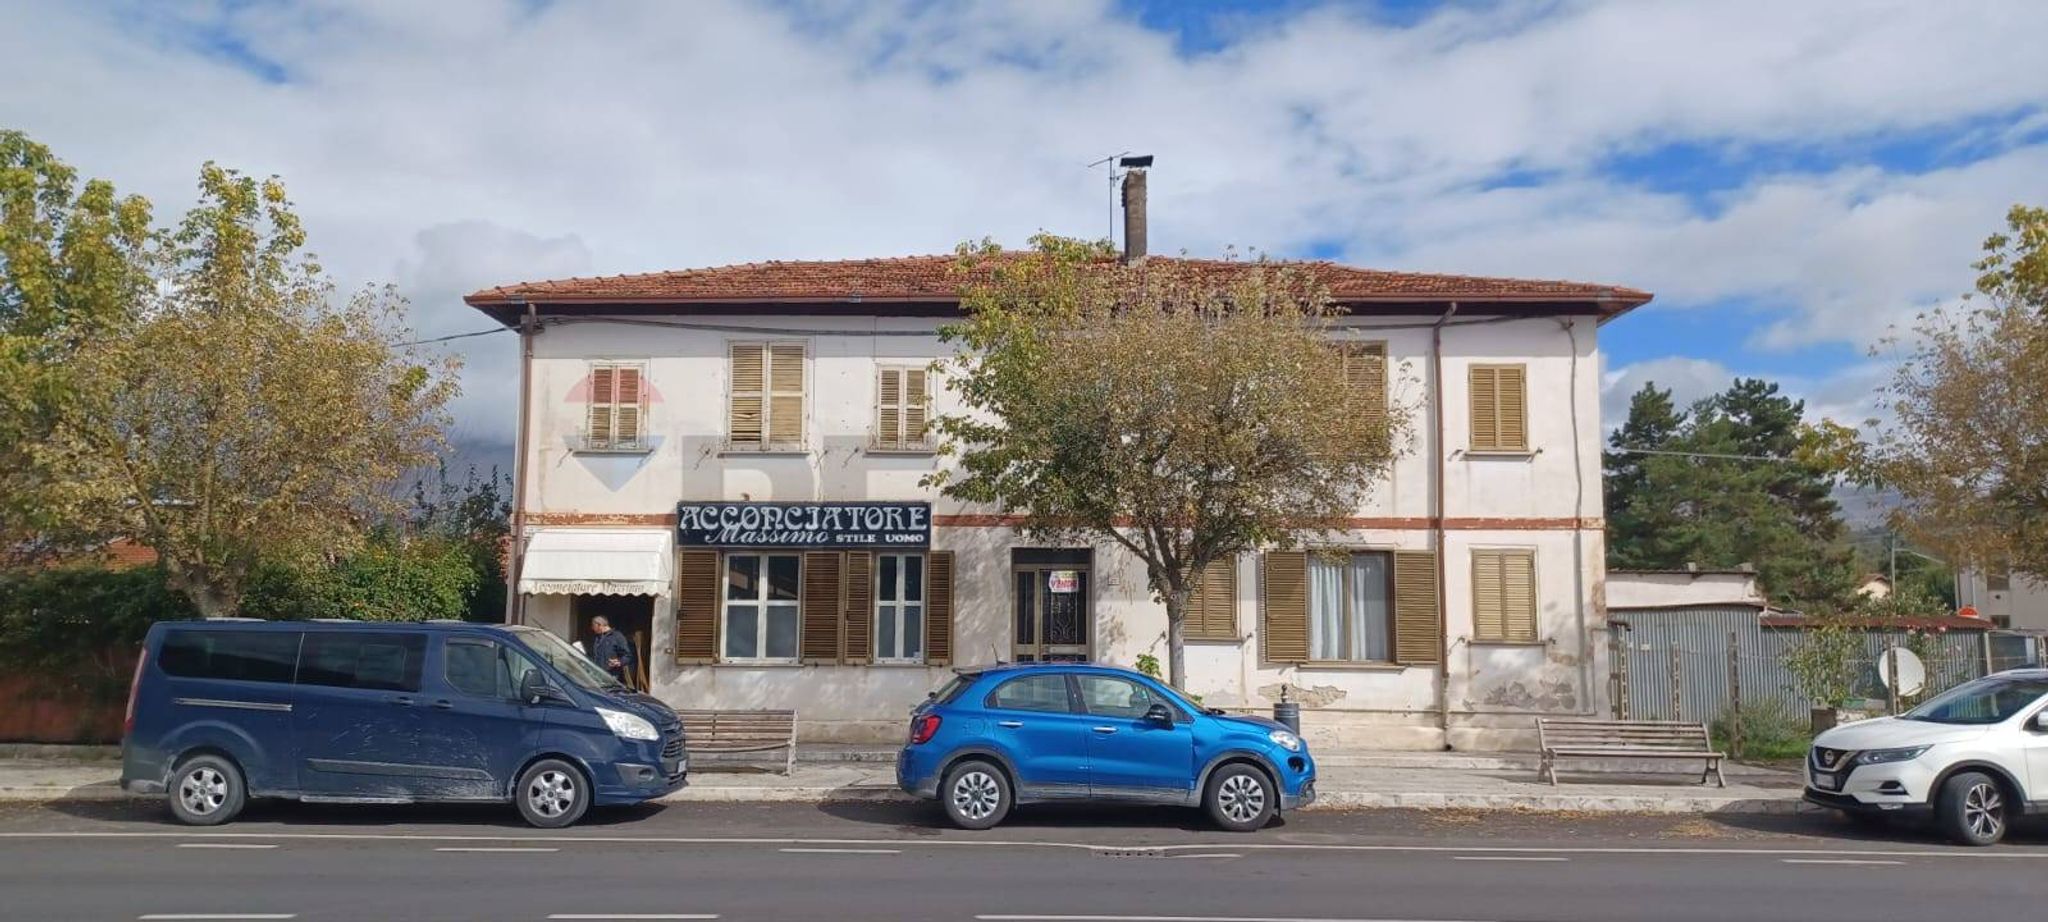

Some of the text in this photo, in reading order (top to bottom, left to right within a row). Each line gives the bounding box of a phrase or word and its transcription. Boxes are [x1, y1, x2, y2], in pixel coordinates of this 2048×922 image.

[679, 506, 928, 531] ACCONCIATORE
[705, 520, 924, 544] Massimo STILE UOMO
